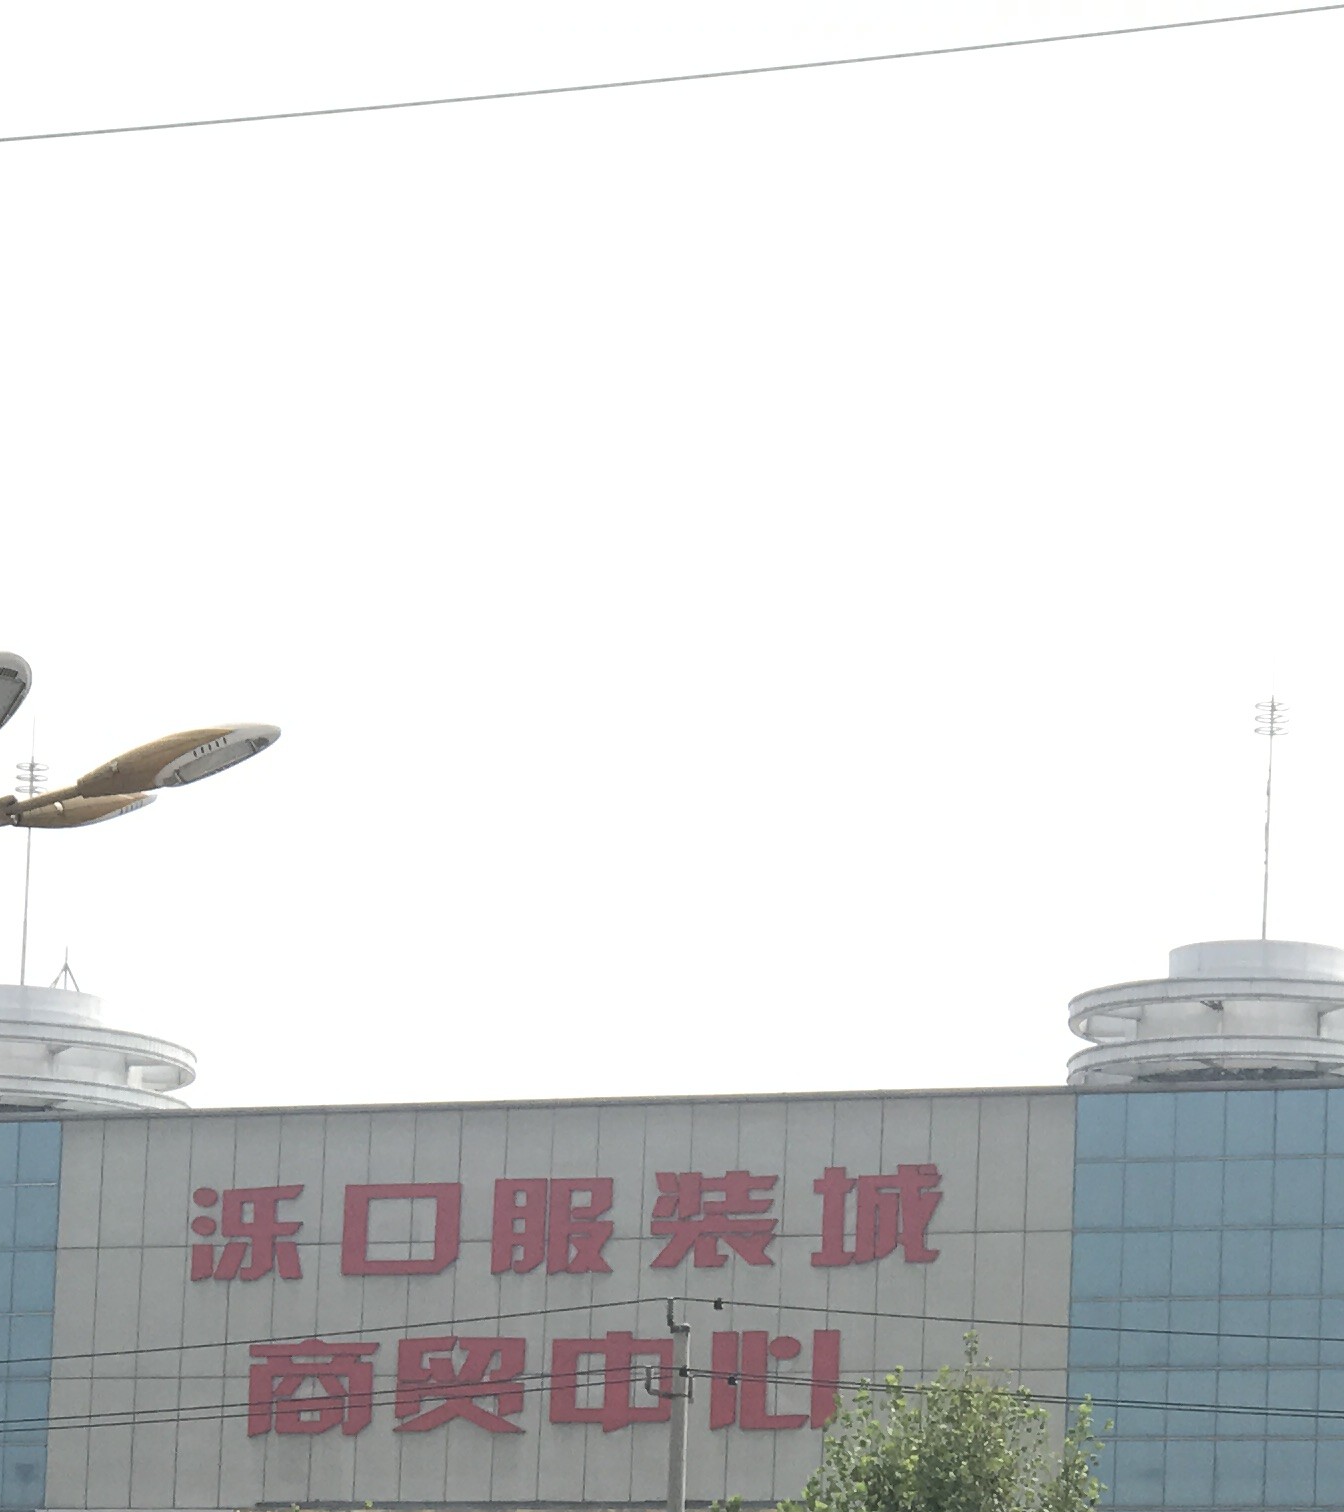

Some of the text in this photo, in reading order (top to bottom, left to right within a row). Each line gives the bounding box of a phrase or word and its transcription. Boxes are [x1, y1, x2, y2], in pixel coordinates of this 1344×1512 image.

[190, 1162, 945, 1282] 泺口服装城
[247, 1329, 841, 1438] 商贸中心
